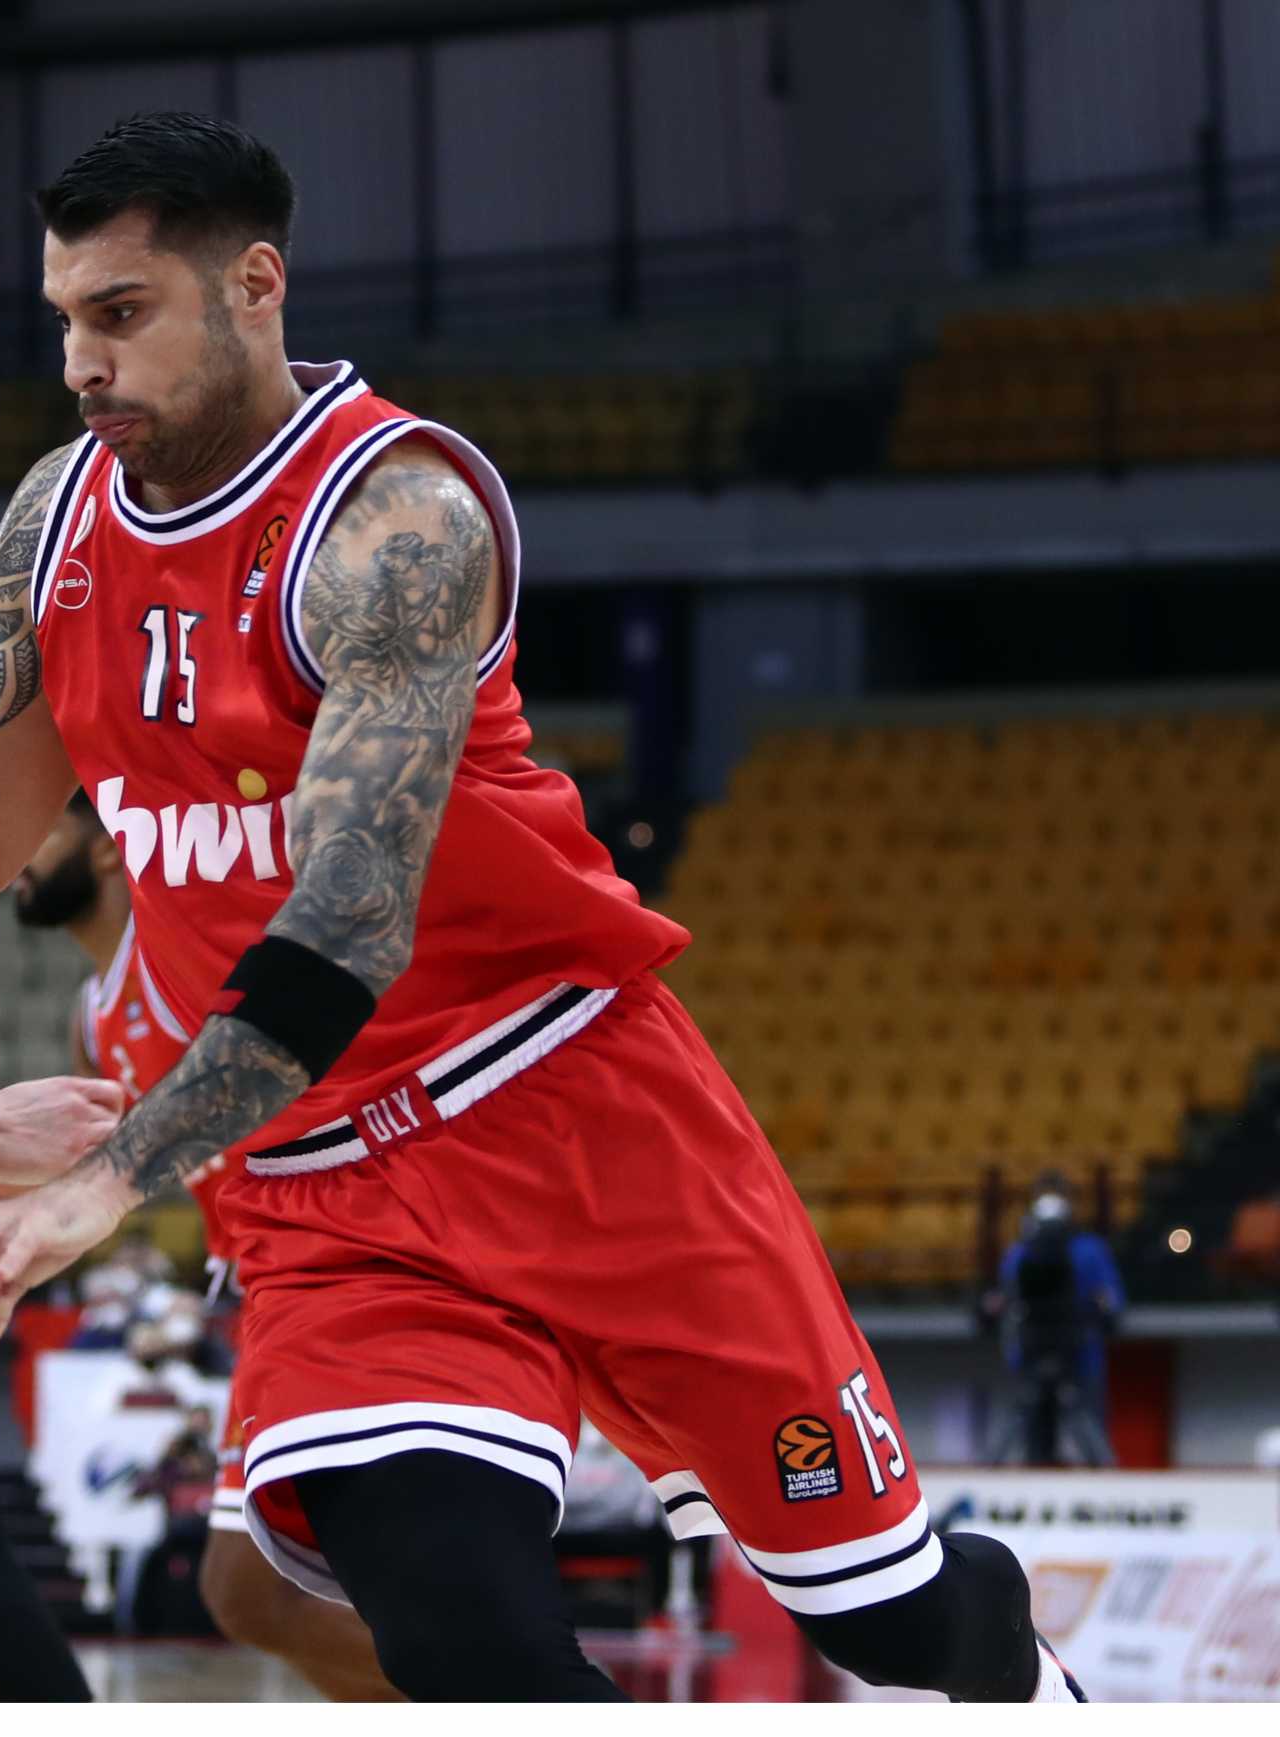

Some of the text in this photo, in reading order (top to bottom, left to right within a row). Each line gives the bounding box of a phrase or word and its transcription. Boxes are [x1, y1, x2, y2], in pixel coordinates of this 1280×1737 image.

[137, 603, 206, 728] 15
[97, 767, 296, 888] bwi
[361, 1086, 421, 1145] OLY
[838, 1367, 907, 1498] 15
[785, 1467, 836, 1483] TURKISH
[787, 1476, 837, 1492] AIRLINES
[788, 1485, 839, 1499] EuroLeague
